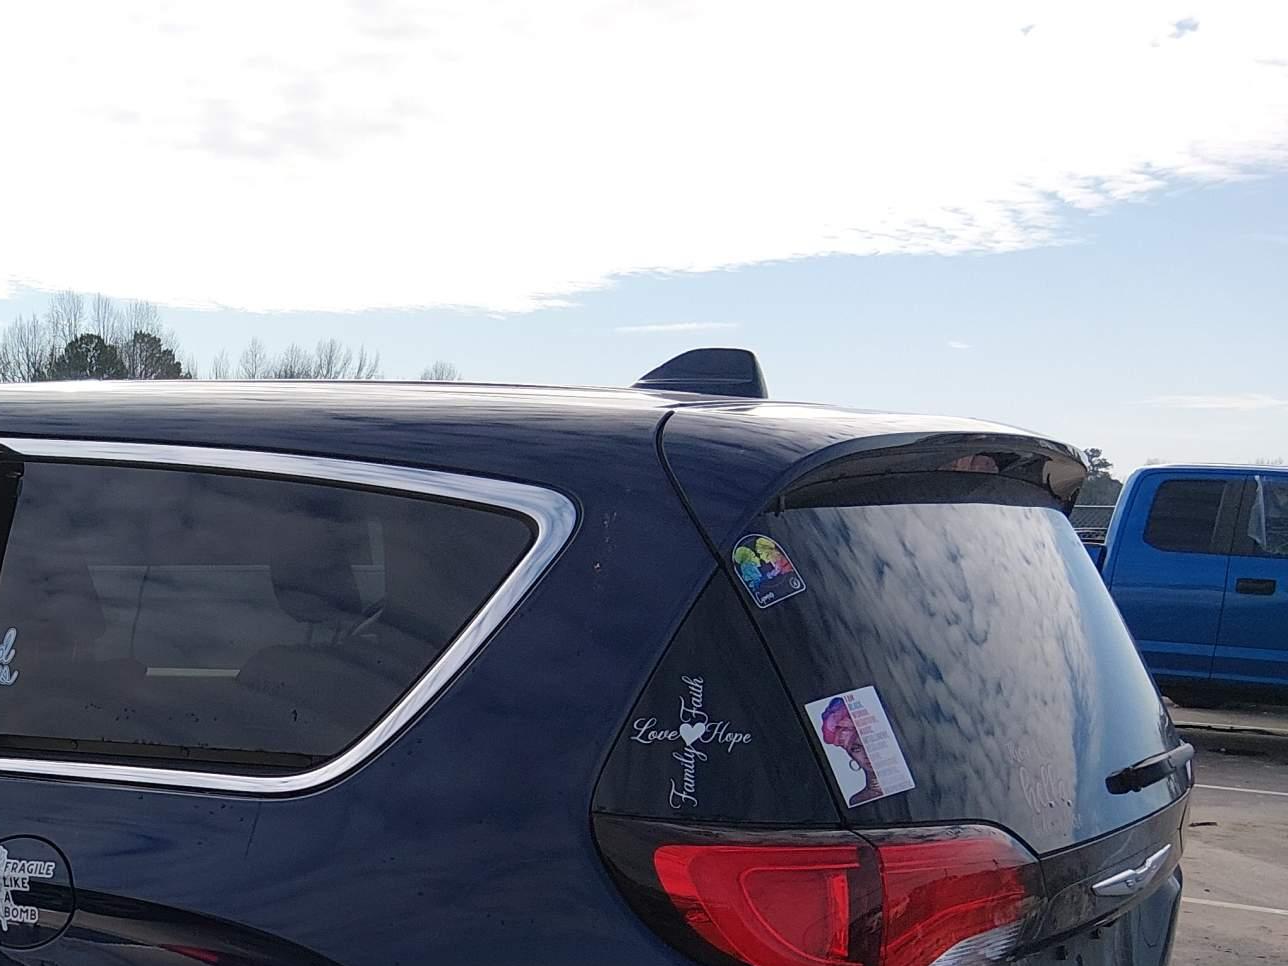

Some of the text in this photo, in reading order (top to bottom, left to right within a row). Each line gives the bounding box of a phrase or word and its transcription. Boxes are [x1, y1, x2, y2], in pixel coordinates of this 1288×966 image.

[679, 675, 709, 724] Faith
[630, 717, 681, 744] Love
[699, 721, 752, 753] Hope
[669, 744, 708, 809] Family
[4, 861, 55, 876] FRAGILE
[3, 876, 29, 889] LIKE
[4, 891, 11, 903] A
[4, 906, 37, 920] BOMB
